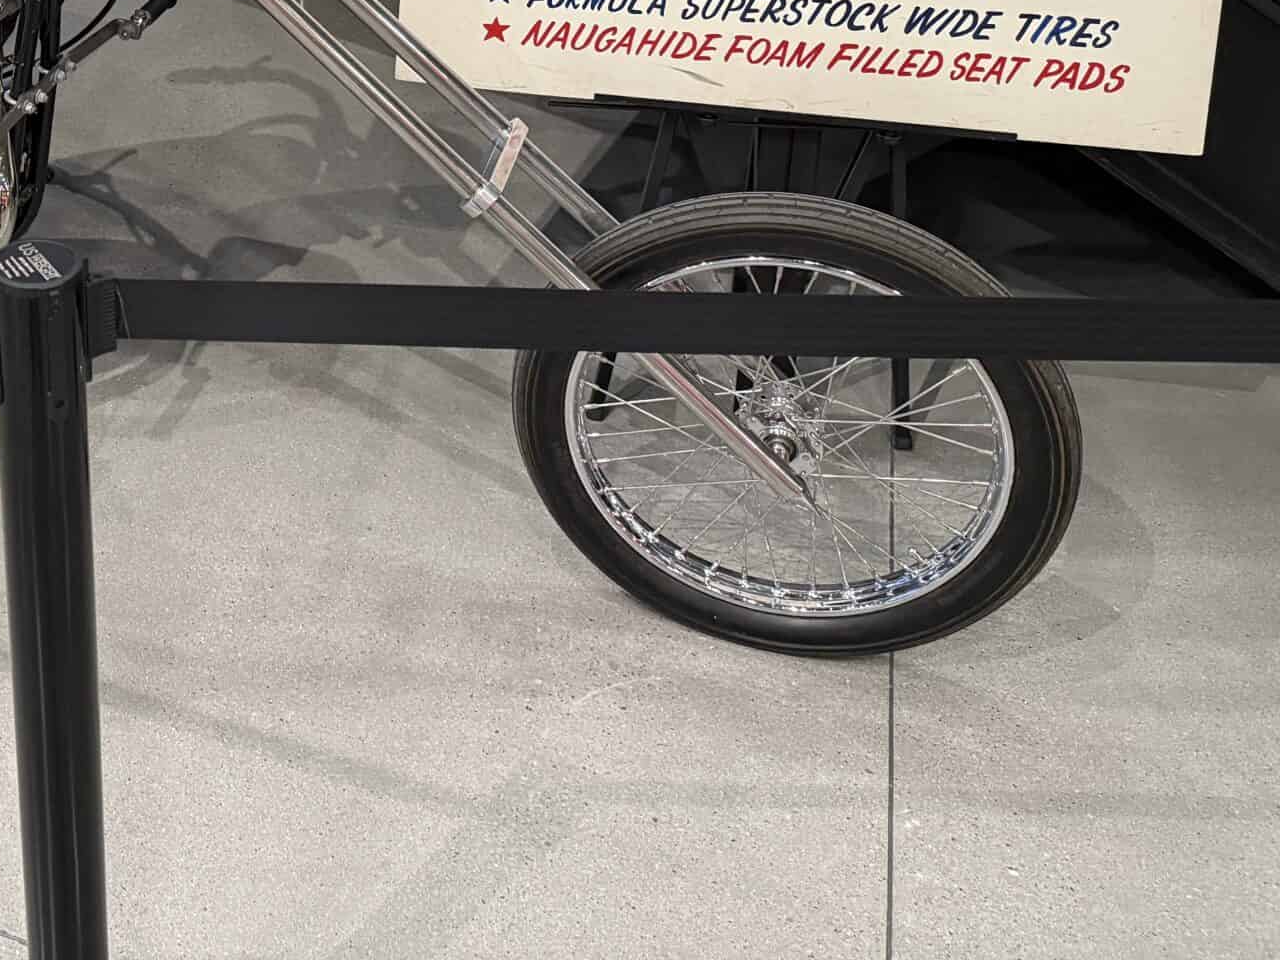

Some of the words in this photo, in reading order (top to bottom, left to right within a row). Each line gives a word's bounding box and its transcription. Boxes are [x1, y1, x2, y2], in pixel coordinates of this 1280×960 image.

[521, 19, 723, 63] NAUGAHIDE
[723, 34, 826, 73] FOAM
[826, 42, 945, 80] FILLED
[949, 51, 1031, 85] SEAT
[1032, 58, 1132, 95] PADS
[903, 5, 1004, 42] WIDE
[1015, 13, 1120, 50] TIRES
